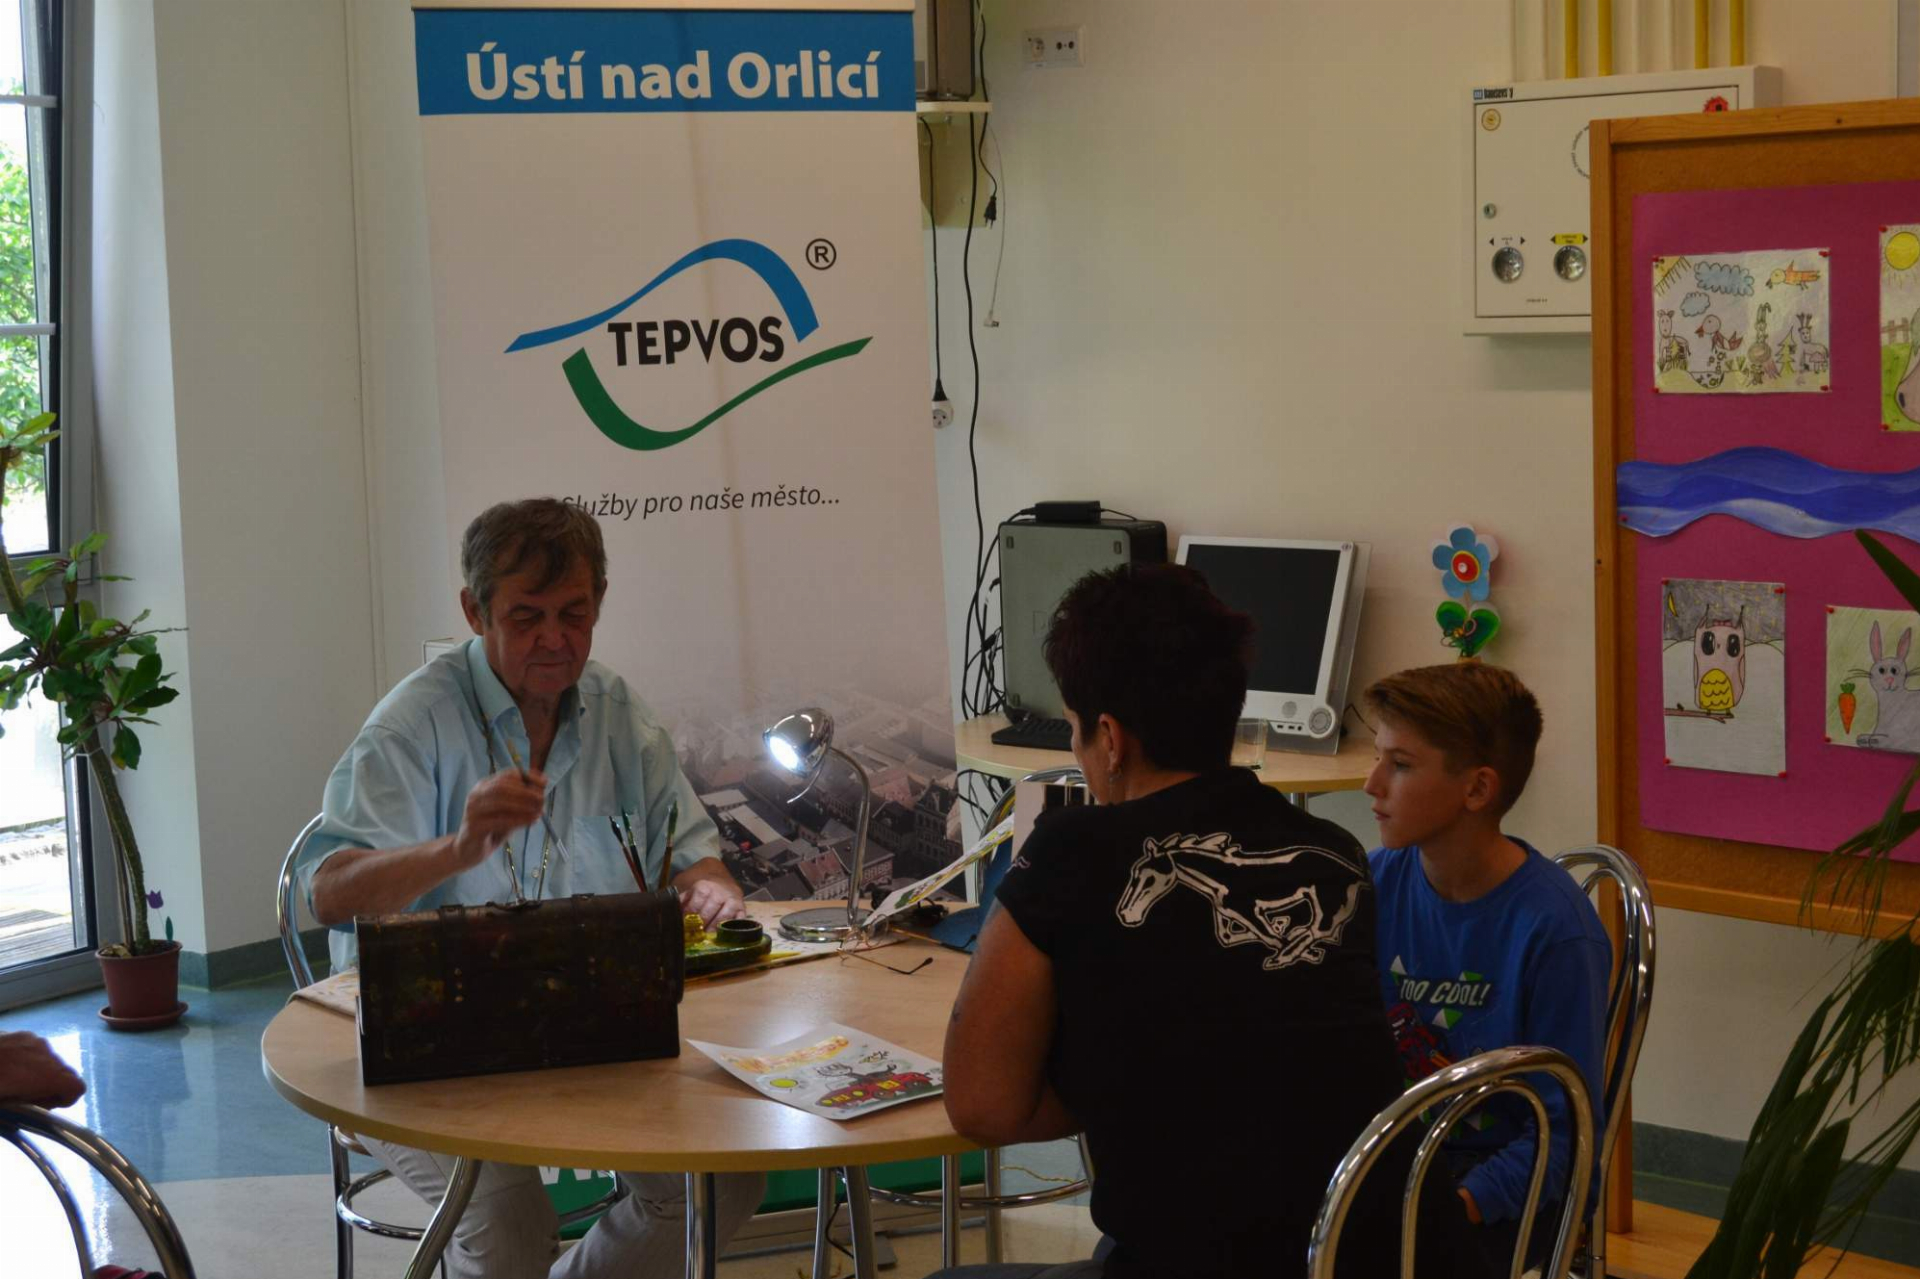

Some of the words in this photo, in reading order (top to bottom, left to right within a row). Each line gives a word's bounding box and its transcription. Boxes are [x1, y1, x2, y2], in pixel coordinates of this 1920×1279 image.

[466, 42, 586, 100] Ústí
[601, 50, 712, 99] nad
[727, 50, 882, 99] Orlicí
[607, 316, 785, 367] TEPVOS
[643, 495, 683, 519] pro
[689, 487, 744, 511] naše
[750, 484, 840, 509] město...
[1400, 978, 1430, 1002] TOO
[1430, 980, 1491, 1006] COOL!
